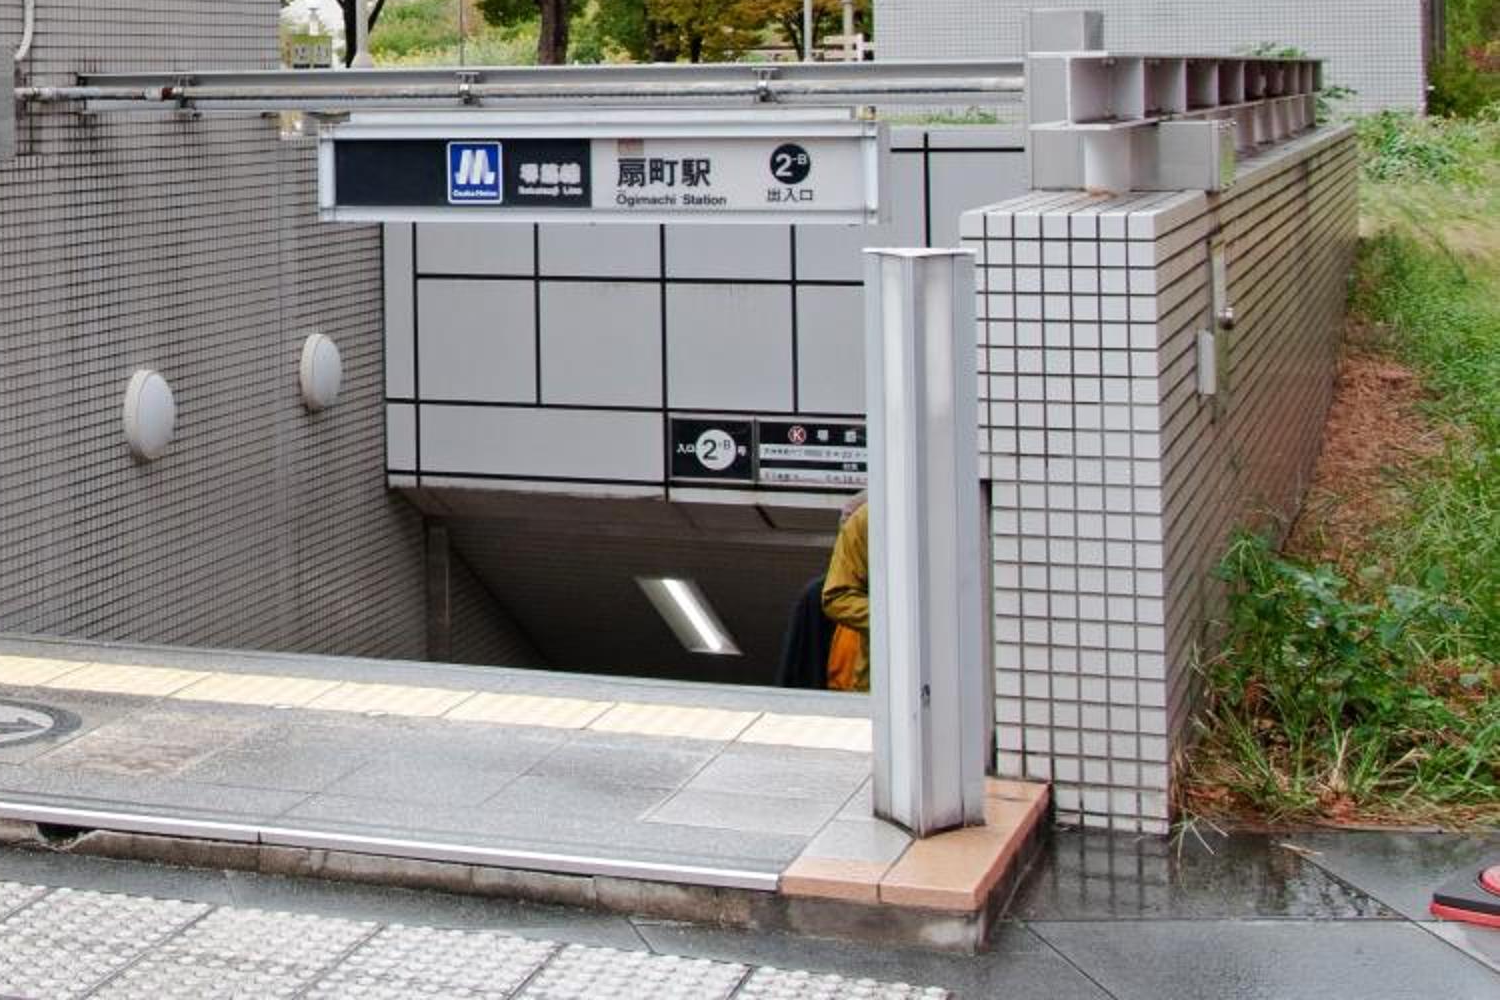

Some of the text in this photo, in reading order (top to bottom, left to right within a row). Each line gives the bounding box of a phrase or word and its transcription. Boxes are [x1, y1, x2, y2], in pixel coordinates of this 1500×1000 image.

[617, 158, 711, 187] 扇町駅
[775, 153, 807, 177] 2-B
[682, 193, 727, 205] Station
[767, 189, 814, 202] 出入口
